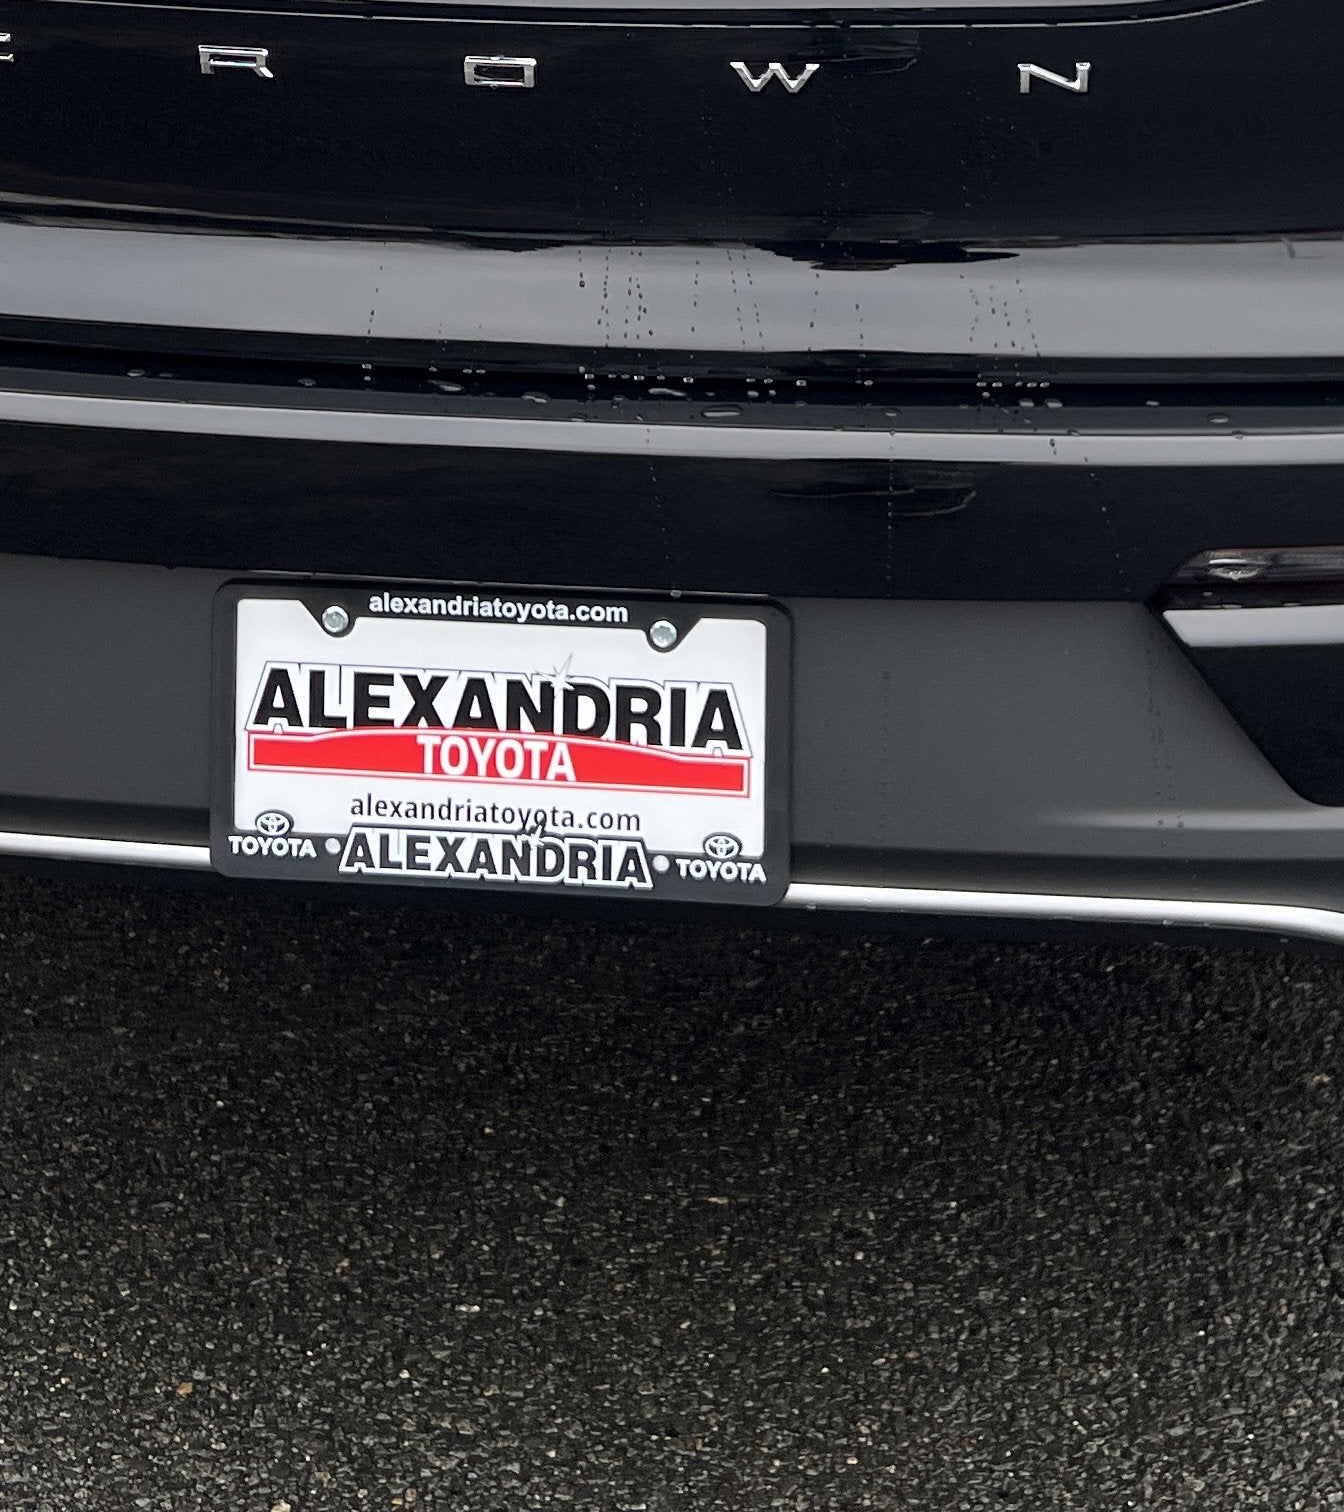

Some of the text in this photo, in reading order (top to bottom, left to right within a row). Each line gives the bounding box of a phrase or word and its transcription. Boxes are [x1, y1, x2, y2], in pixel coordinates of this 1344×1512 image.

[368, 591, 629, 623] alexandriatoyota.com
[253, 666, 744, 752] ALEXANDRIA
[416, 734, 577, 782] TOYOTA
[350, 792, 641, 834] alexandriatoyota.com
[227, 835, 318, 859] TOYOTA
[342, 830, 649, 886] ALEXANDRIA
[675, 858, 768, 885] TOYOTA
